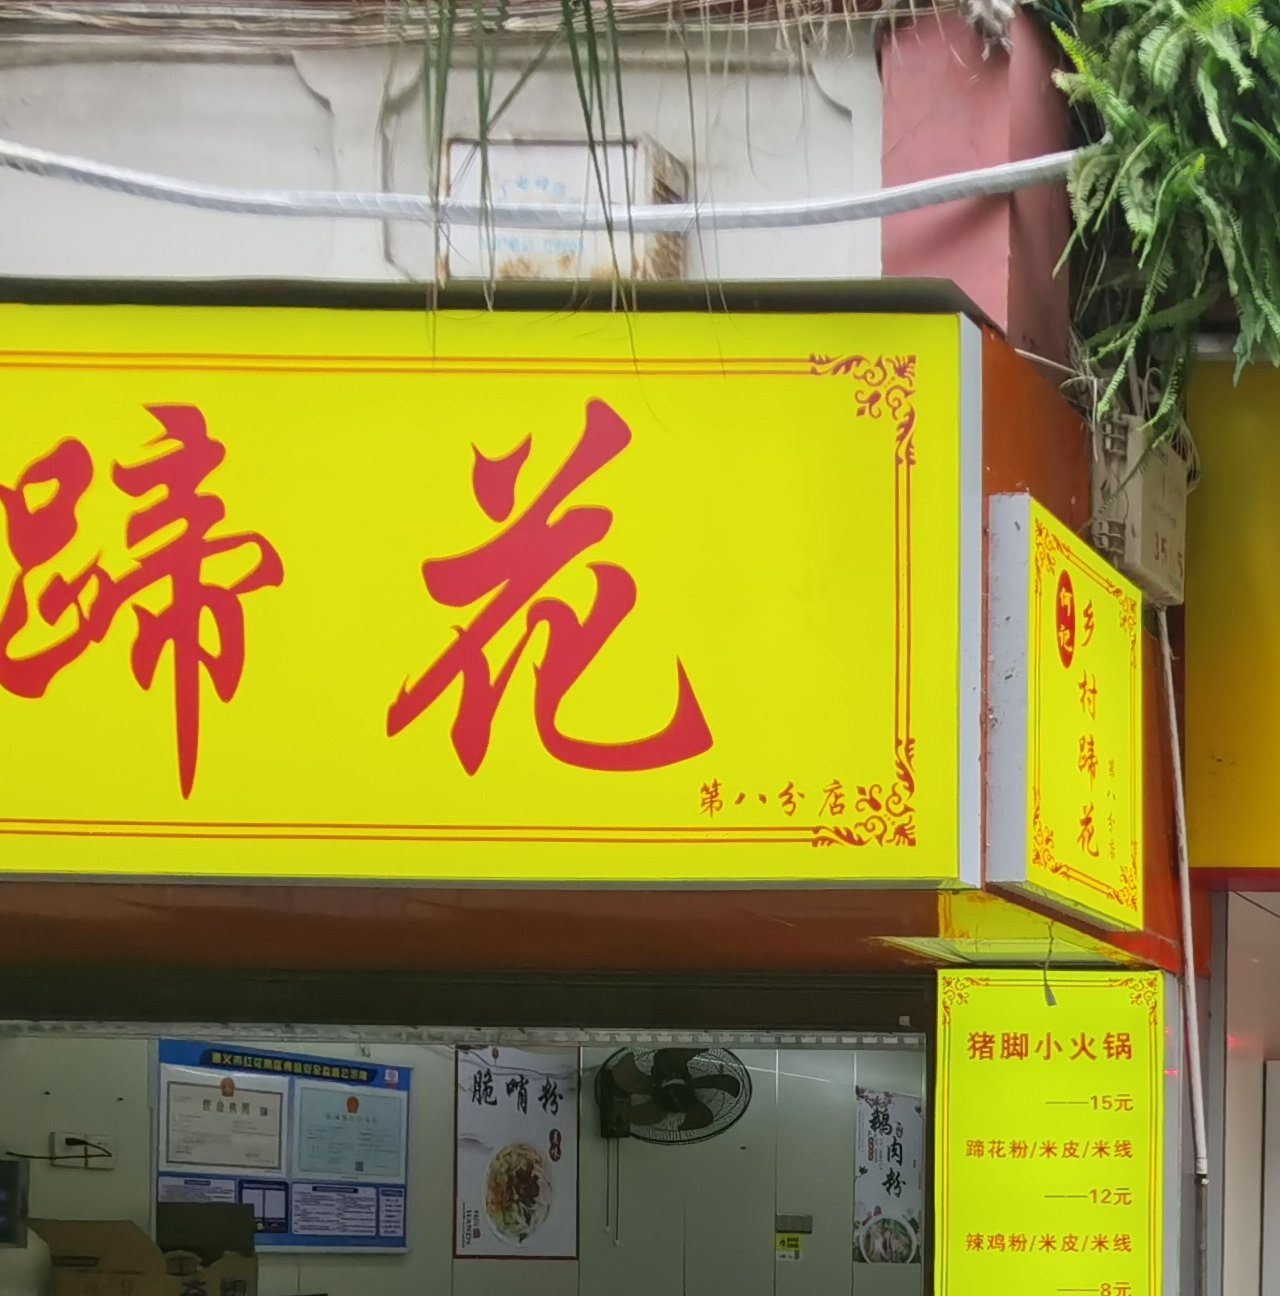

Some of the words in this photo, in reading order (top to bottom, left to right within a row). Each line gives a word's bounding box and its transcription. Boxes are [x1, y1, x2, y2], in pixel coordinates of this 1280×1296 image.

[1076, 600, 1100, 858] 乡村蹄花
[699, 777, 847, 819] 第八分店
[967, 1031, 1134, 1061] 猪脚小火锅
[472, 1067, 564, 1115] 脆哨粉
[869, 1109, 907, 1198] 鹅肉粉
[966, 1139, 1134, 1160] 蹄花粉/米皮/米线
[966, 1233, 1133, 1254] 辣鸡粉/米皮/米线
